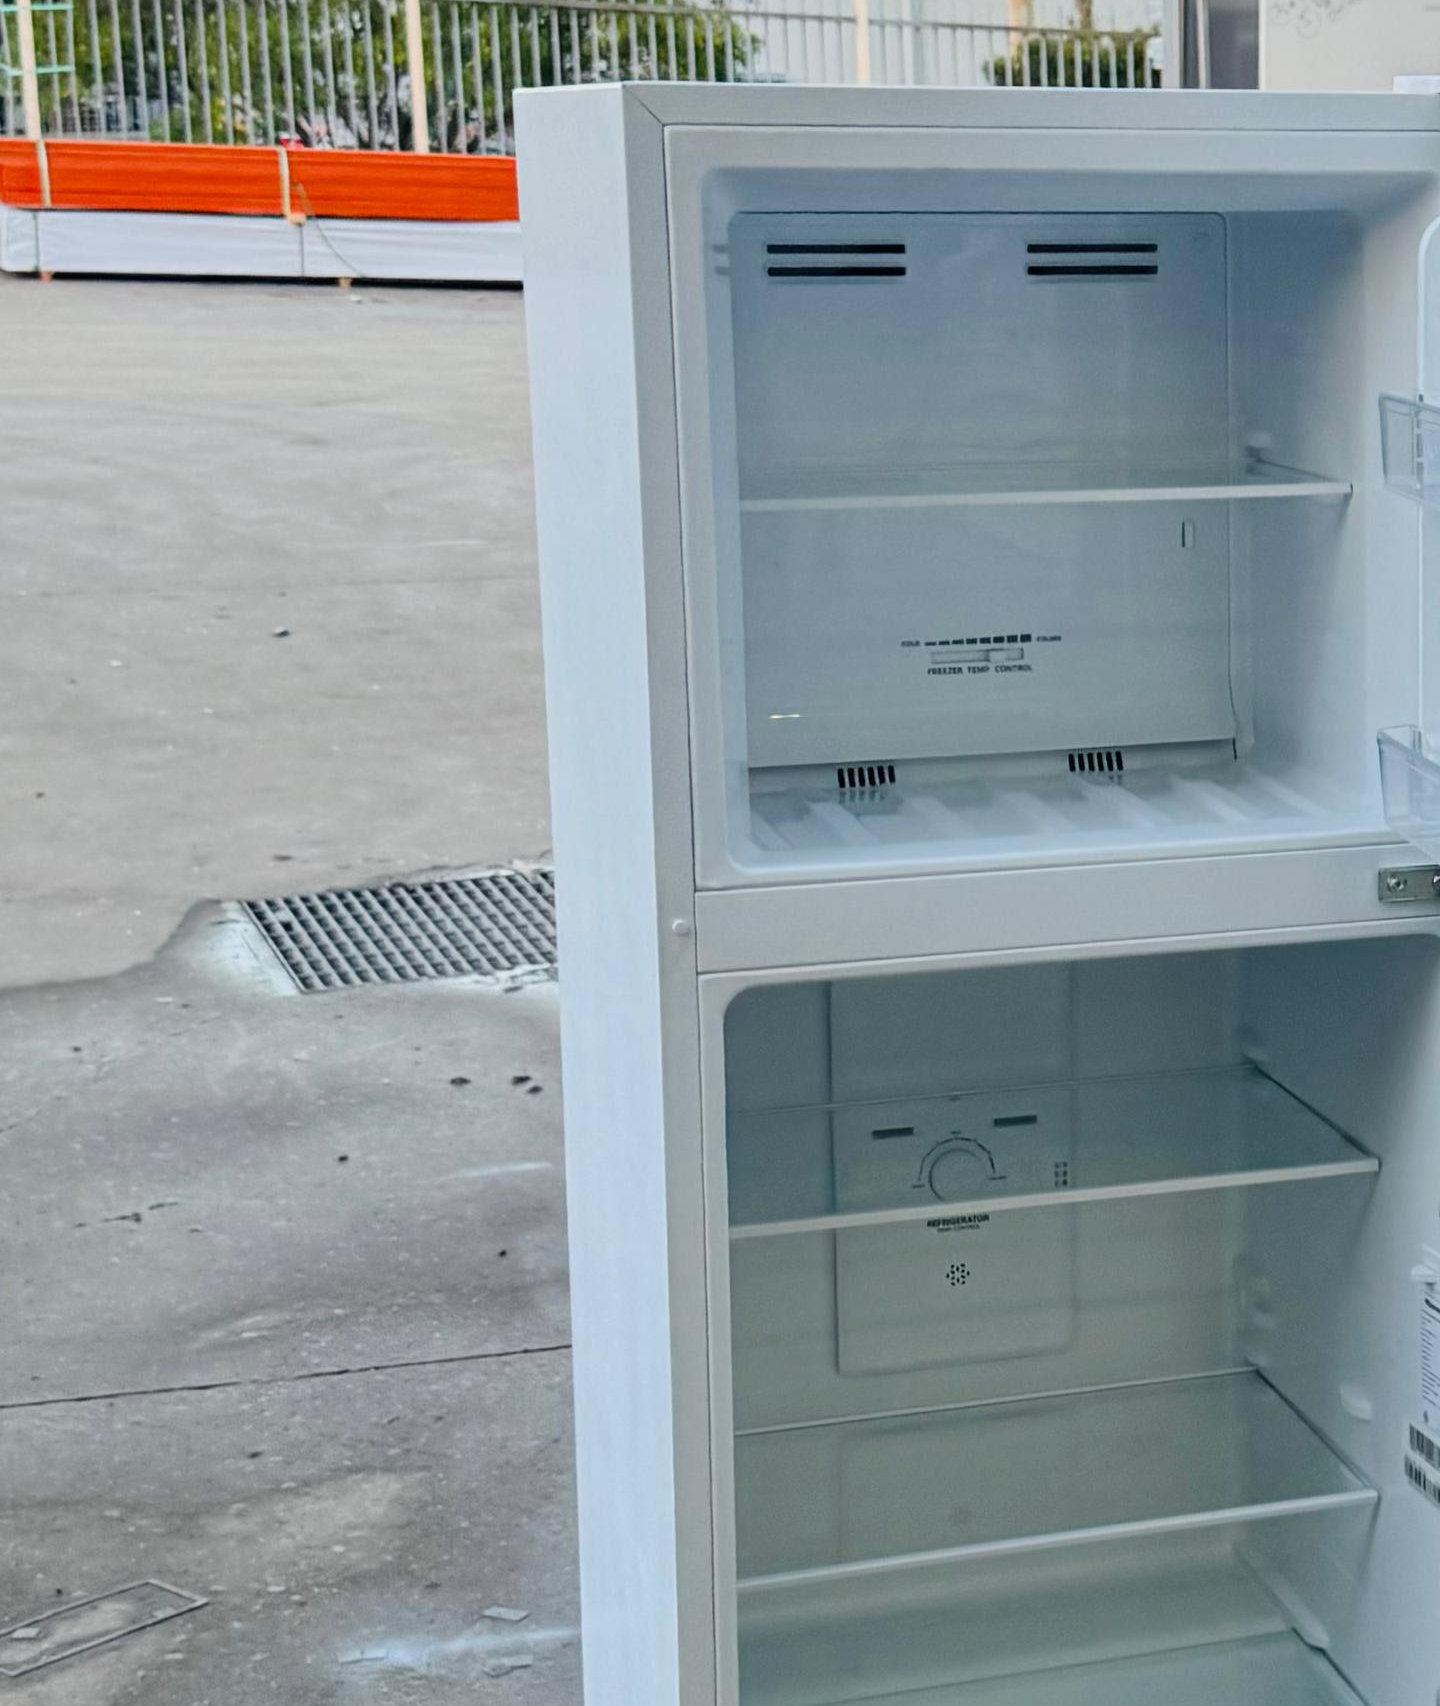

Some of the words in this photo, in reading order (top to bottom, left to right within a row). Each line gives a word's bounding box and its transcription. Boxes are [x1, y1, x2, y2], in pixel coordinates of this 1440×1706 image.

[928, 666, 963, 675] FREEZER
[967, 665, 990, 674] TEMP
[995, 664, 1032, 673] CONTROL
[927, 1214, 990, 1227] REFRIGERATOR
